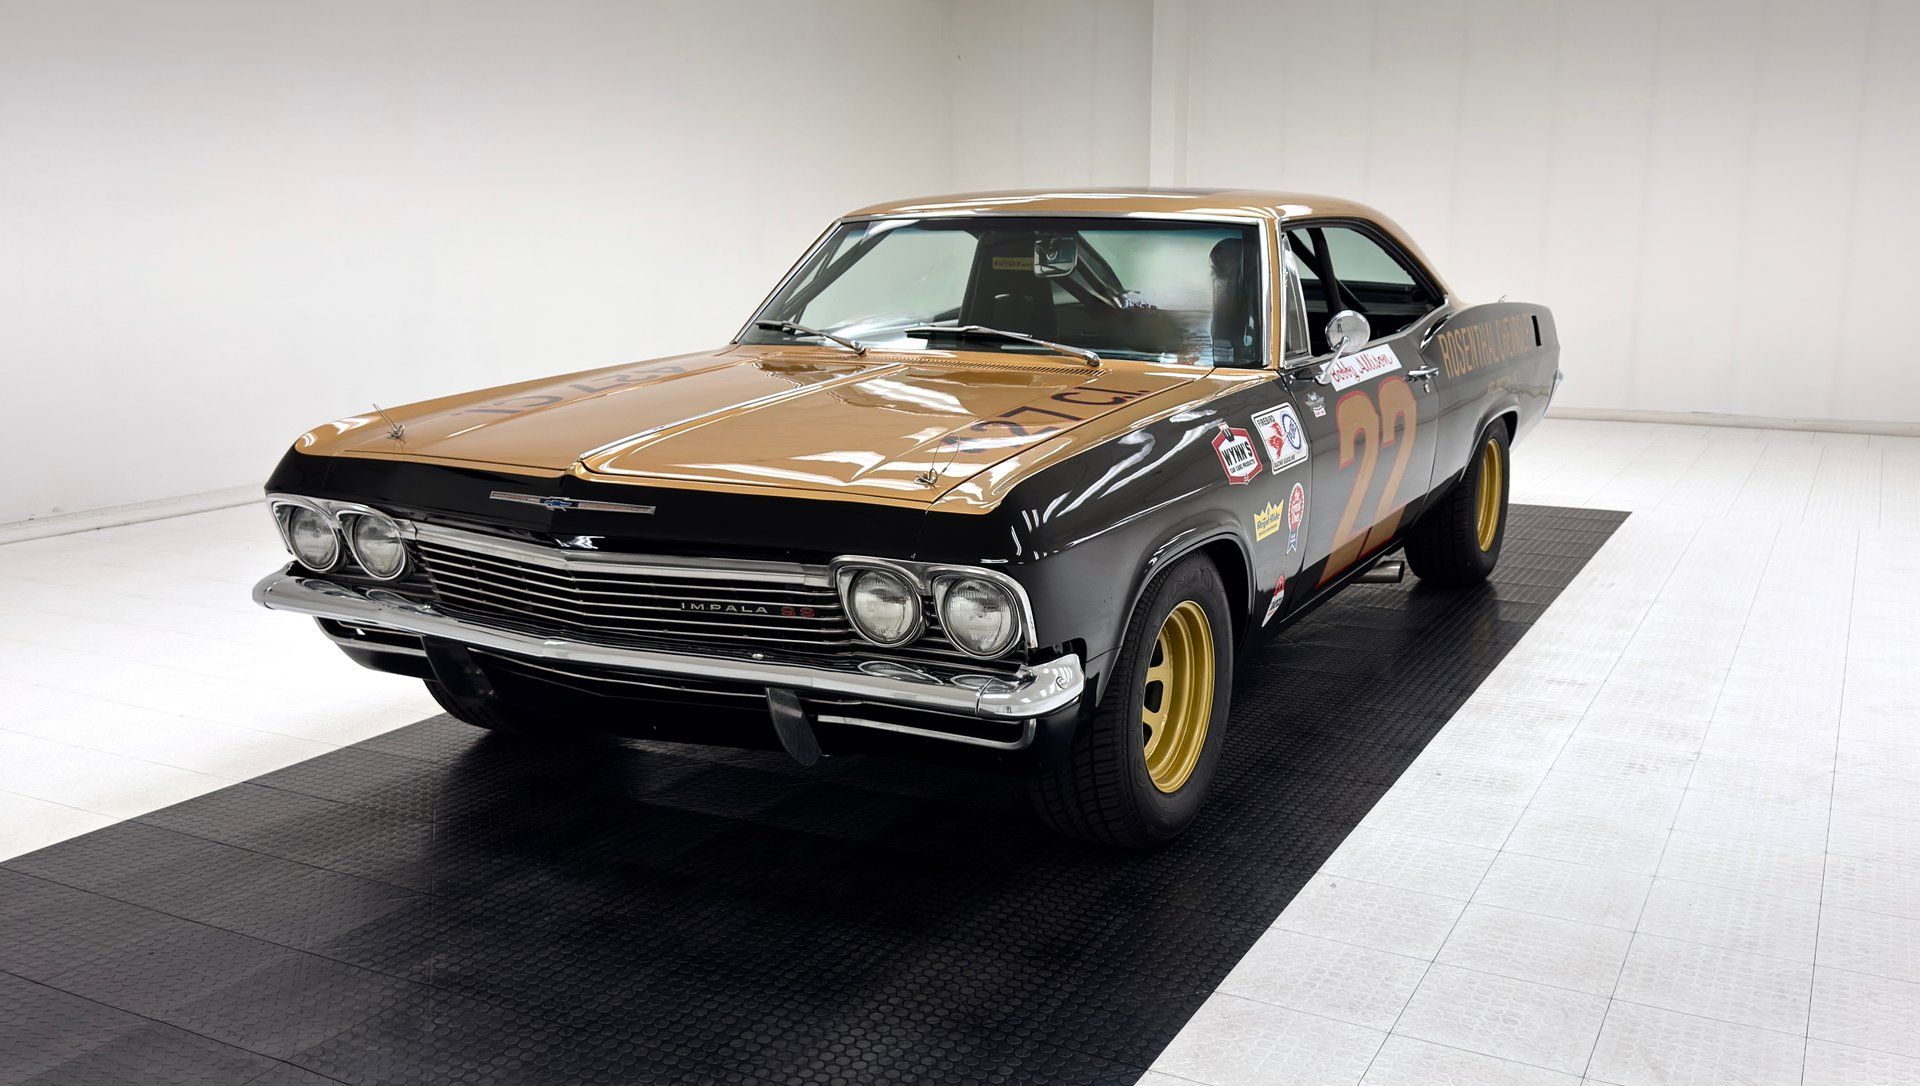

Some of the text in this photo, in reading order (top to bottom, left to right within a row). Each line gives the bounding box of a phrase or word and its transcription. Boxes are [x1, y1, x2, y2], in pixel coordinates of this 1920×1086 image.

[1355, 353, 1394, 374] Allison
[1437, 322, 1499, 379] ROSENTHAL
[1221, 441, 1253, 467] WYNN'S
[1316, 375, 1417, 590] 22
[680, 602, 815, 618] IMPALA SS
